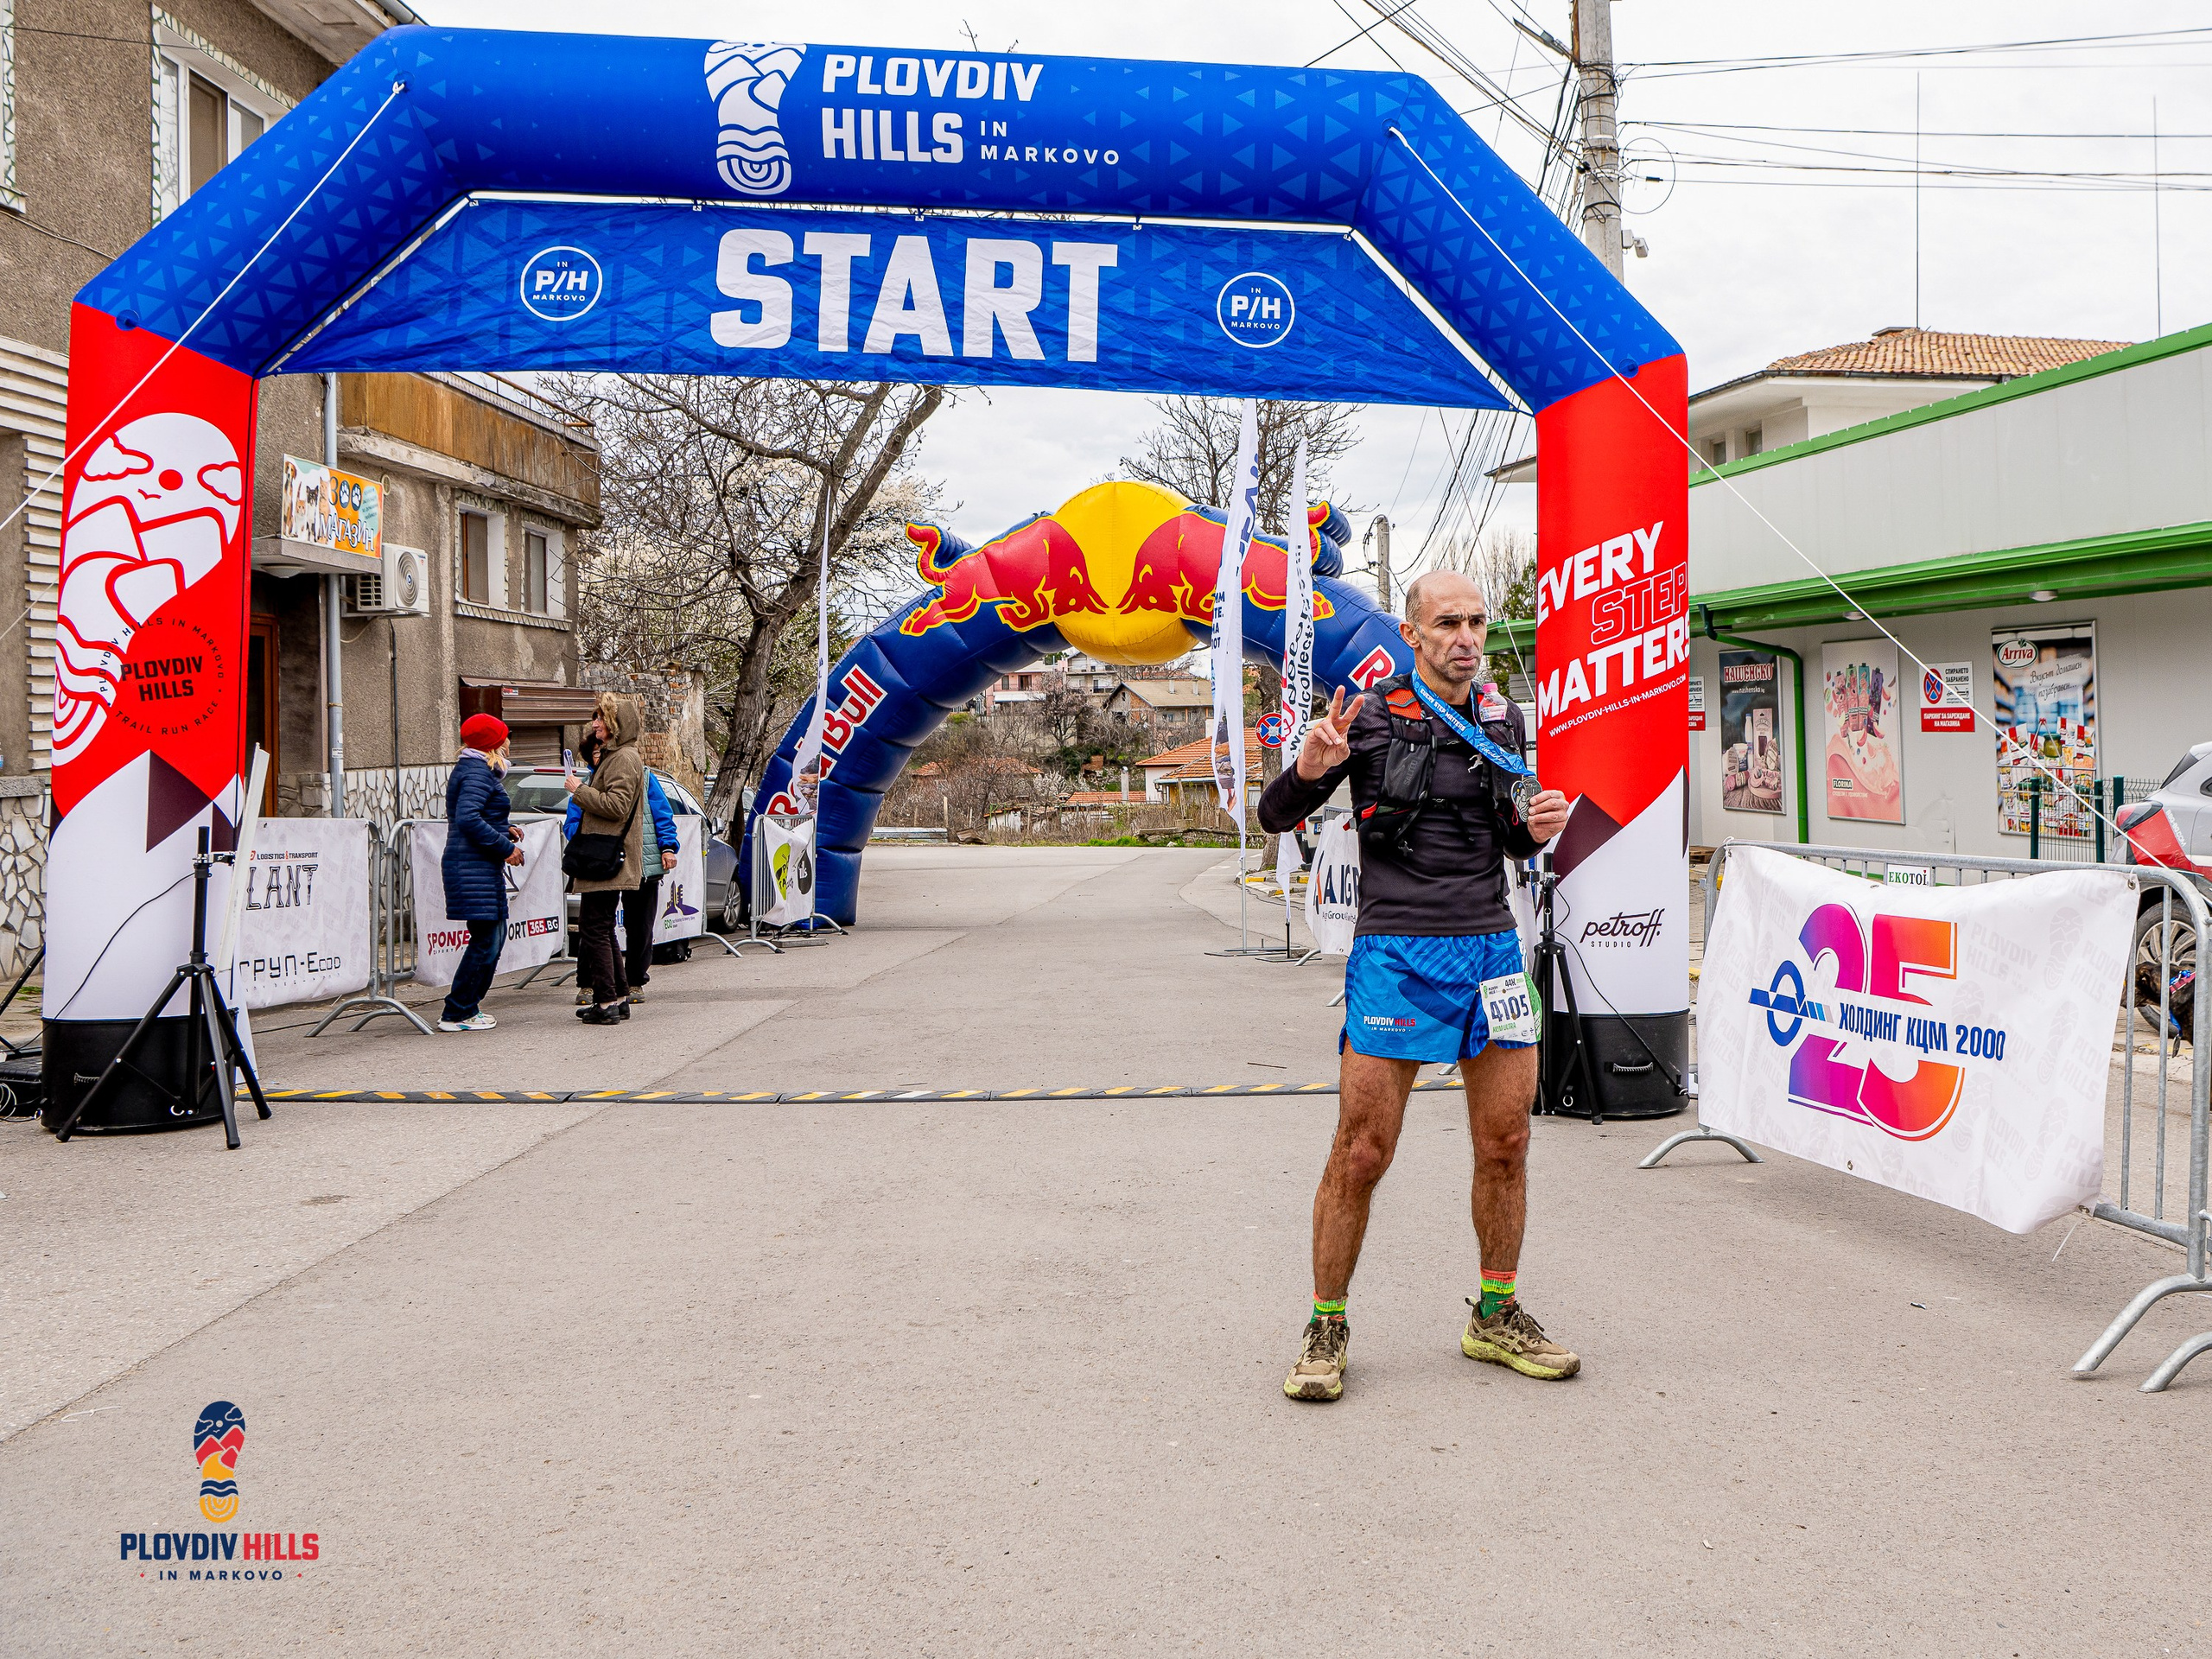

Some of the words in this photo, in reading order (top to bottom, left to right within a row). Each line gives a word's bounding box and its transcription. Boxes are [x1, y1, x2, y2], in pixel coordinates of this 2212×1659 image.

[822, 54, 1044, 102] PLOVDIV
[822, 108, 963, 163] HILLS
[981, 121, 1007, 137] IN
[981, 145, 1120, 165] MARKOVO
[535, 270, 588, 292] P/H
[710, 229, 1118, 363] START
[1231, 295, 1281, 321] P/H
[1231, 321, 1281, 330] MARKOVO
[319, 512, 375, 551] МАГАЗИН
[1537, 520, 1664, 629] EVERY
[1591, 561, 1688, 645] STEP
[172, 618, 186, 627] IN
[2001, 647, 2034, 661] Arriva
[120, 656, 203, 681] PLOVDIV
[1724, 664, 1774, 683] НАШЕНСКО
[138, 679, 194, 702] HILLS
[115, 710, 152, 734] TRAIL
[161, 724, 188, 735] RUN
[194, 701, 219, 727] RACE
[822, 668, 884, 751] Bull
[1548, 673, 1687, 738] WWW.PLOVDIV-HILLS-IN-MARKOVO.COM
[428, 930, 471, 956] SPONSE
[1363, 1016, 1394, 1026] PLOVDIV
[1490, 994, 1529, 1022] 4105
[1839, 1002, 1902, 1042] ХОЛДИНГ
[1906, 1016, 1948, 1054] КЦМ
[1955, 1024, 2006, 1061] 2000
